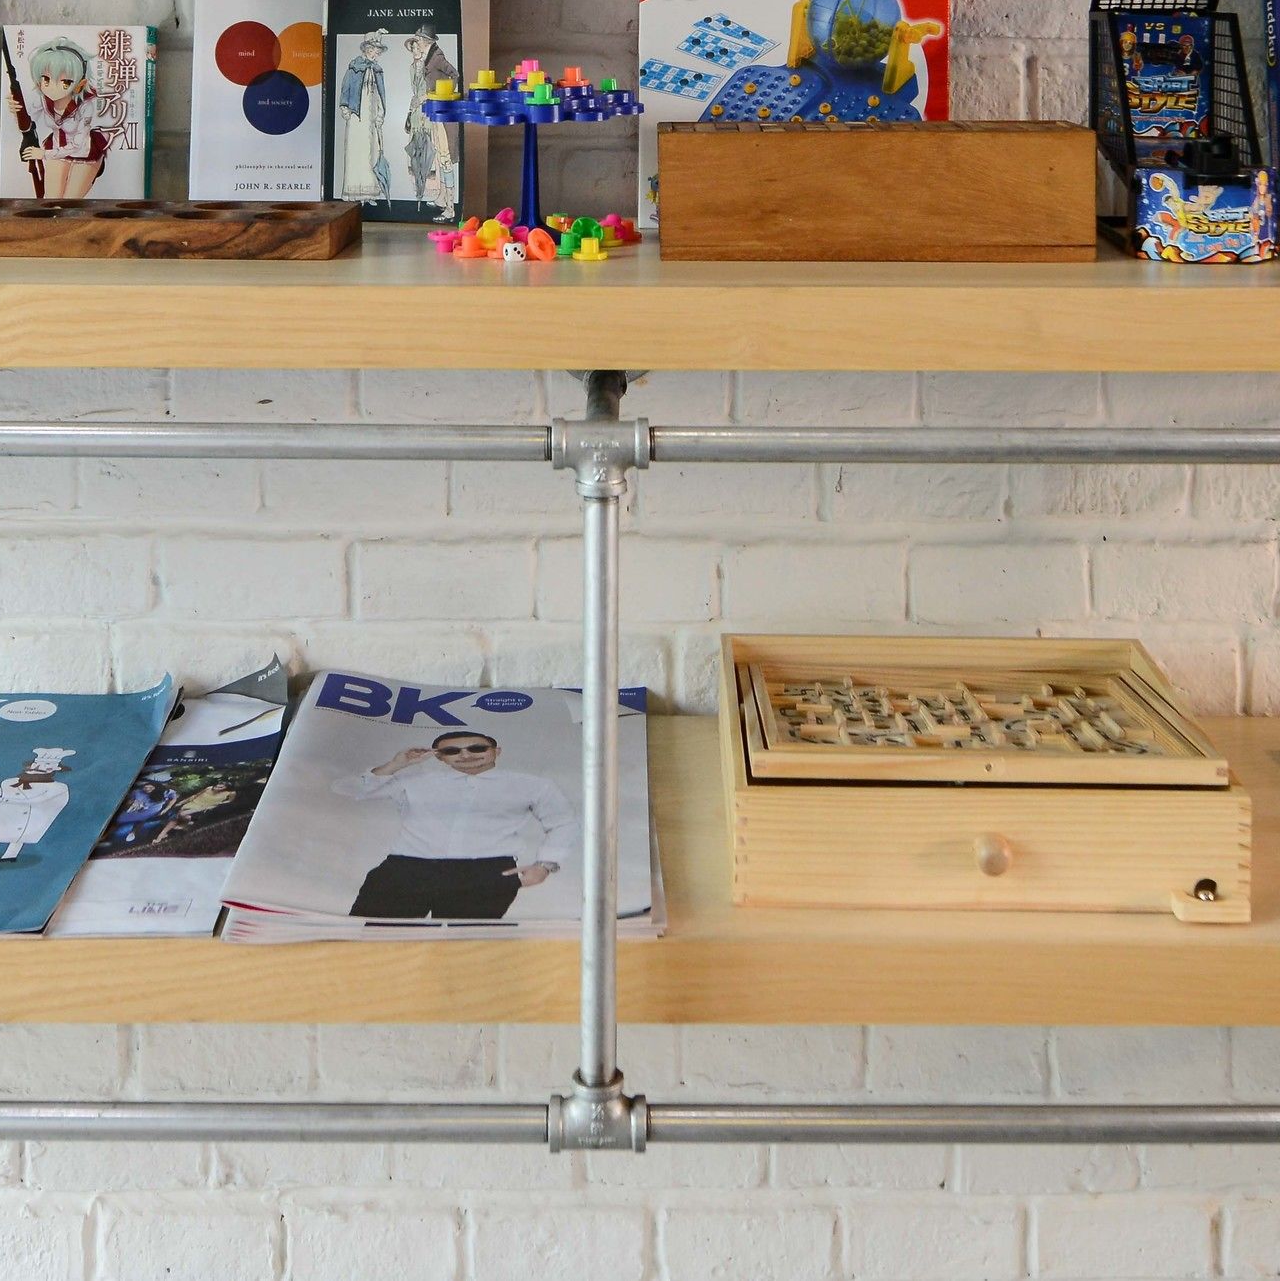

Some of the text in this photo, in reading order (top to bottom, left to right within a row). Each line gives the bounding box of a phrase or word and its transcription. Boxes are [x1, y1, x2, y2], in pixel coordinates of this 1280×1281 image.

[366, 8, 435, 18] JANE AUSTEN
[238, 49, 256, 57] mind
[96, 29, 139, 152] 緋弾のアリア
[257, 98, 294, 108] and society
[234, 182, 312, 191] JOHN R. SEARLE
[256, 663, 281, 683] it's free!
[315, 673, 478, 727] BK
[484, 697, 515, 705] Straight
[500, 701, 523, 709] point
